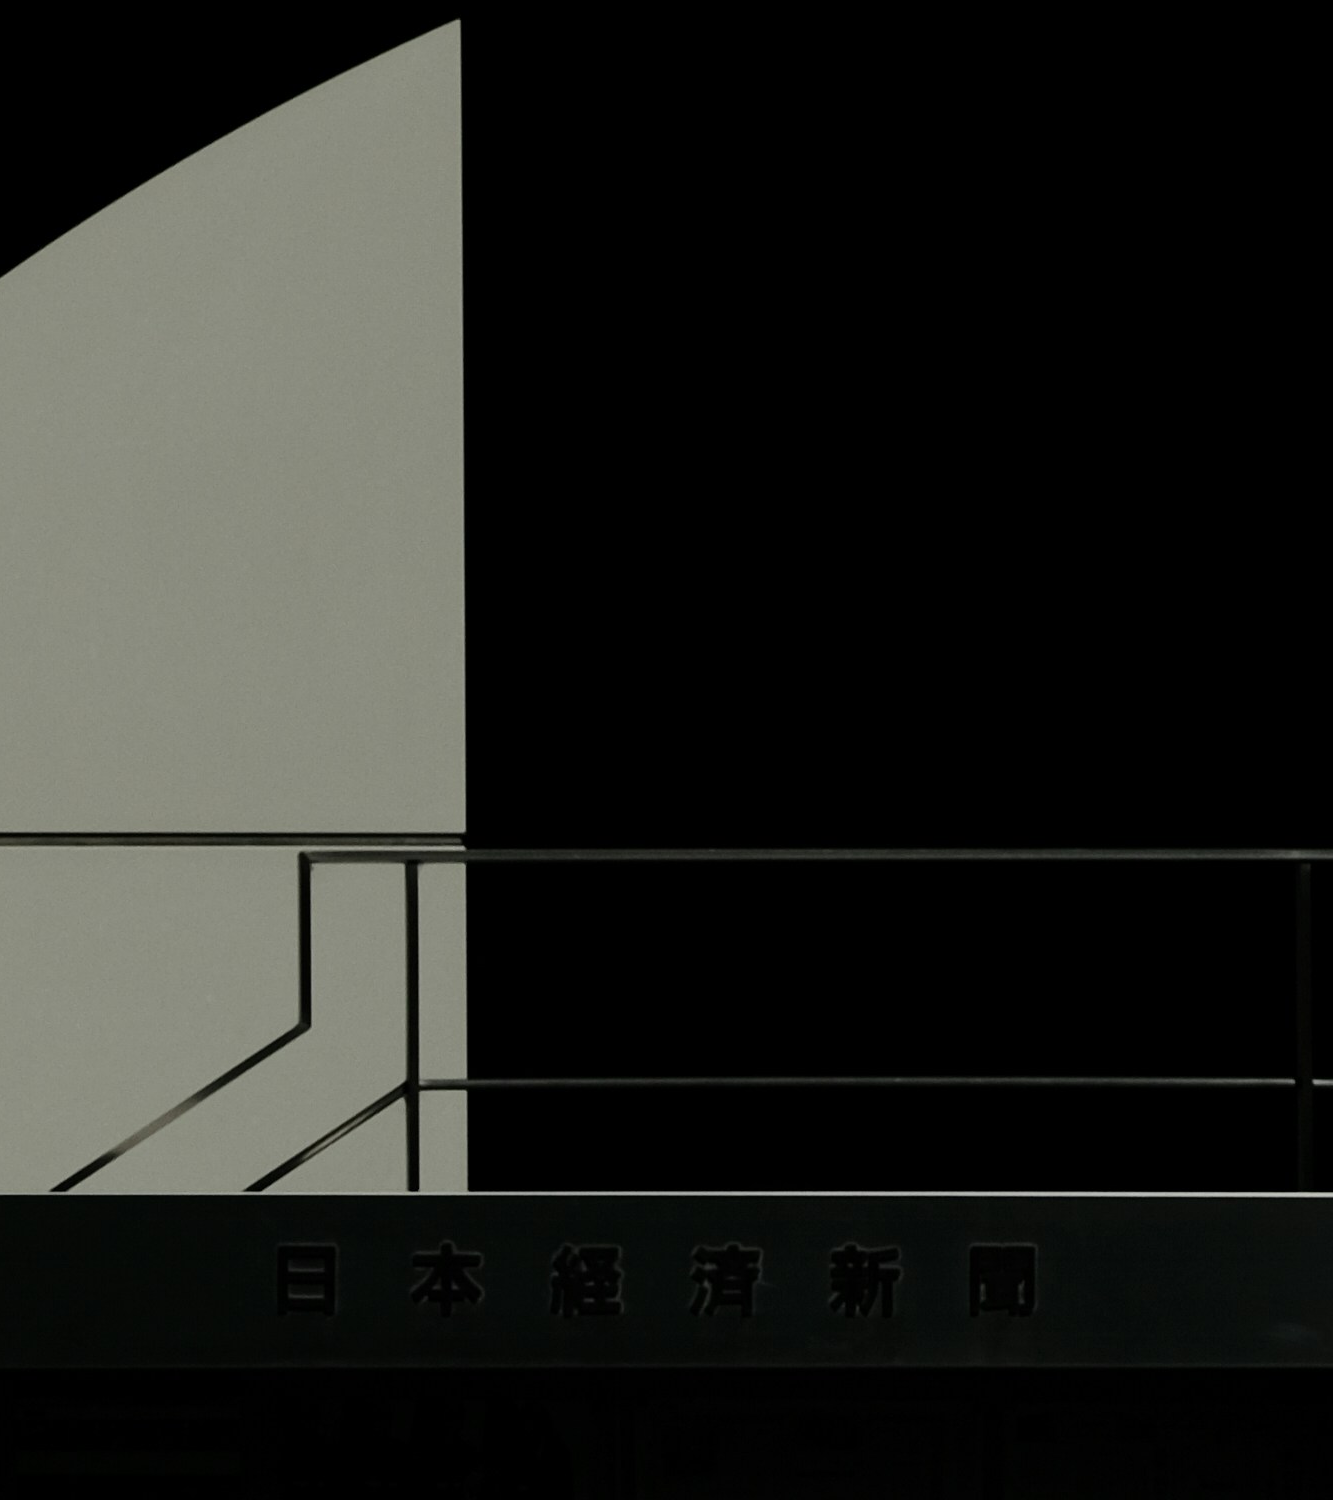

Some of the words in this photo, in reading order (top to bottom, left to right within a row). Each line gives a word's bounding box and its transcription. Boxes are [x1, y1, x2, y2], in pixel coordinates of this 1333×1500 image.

[276, 1243, 1038, 1318] 日本経済新聞
